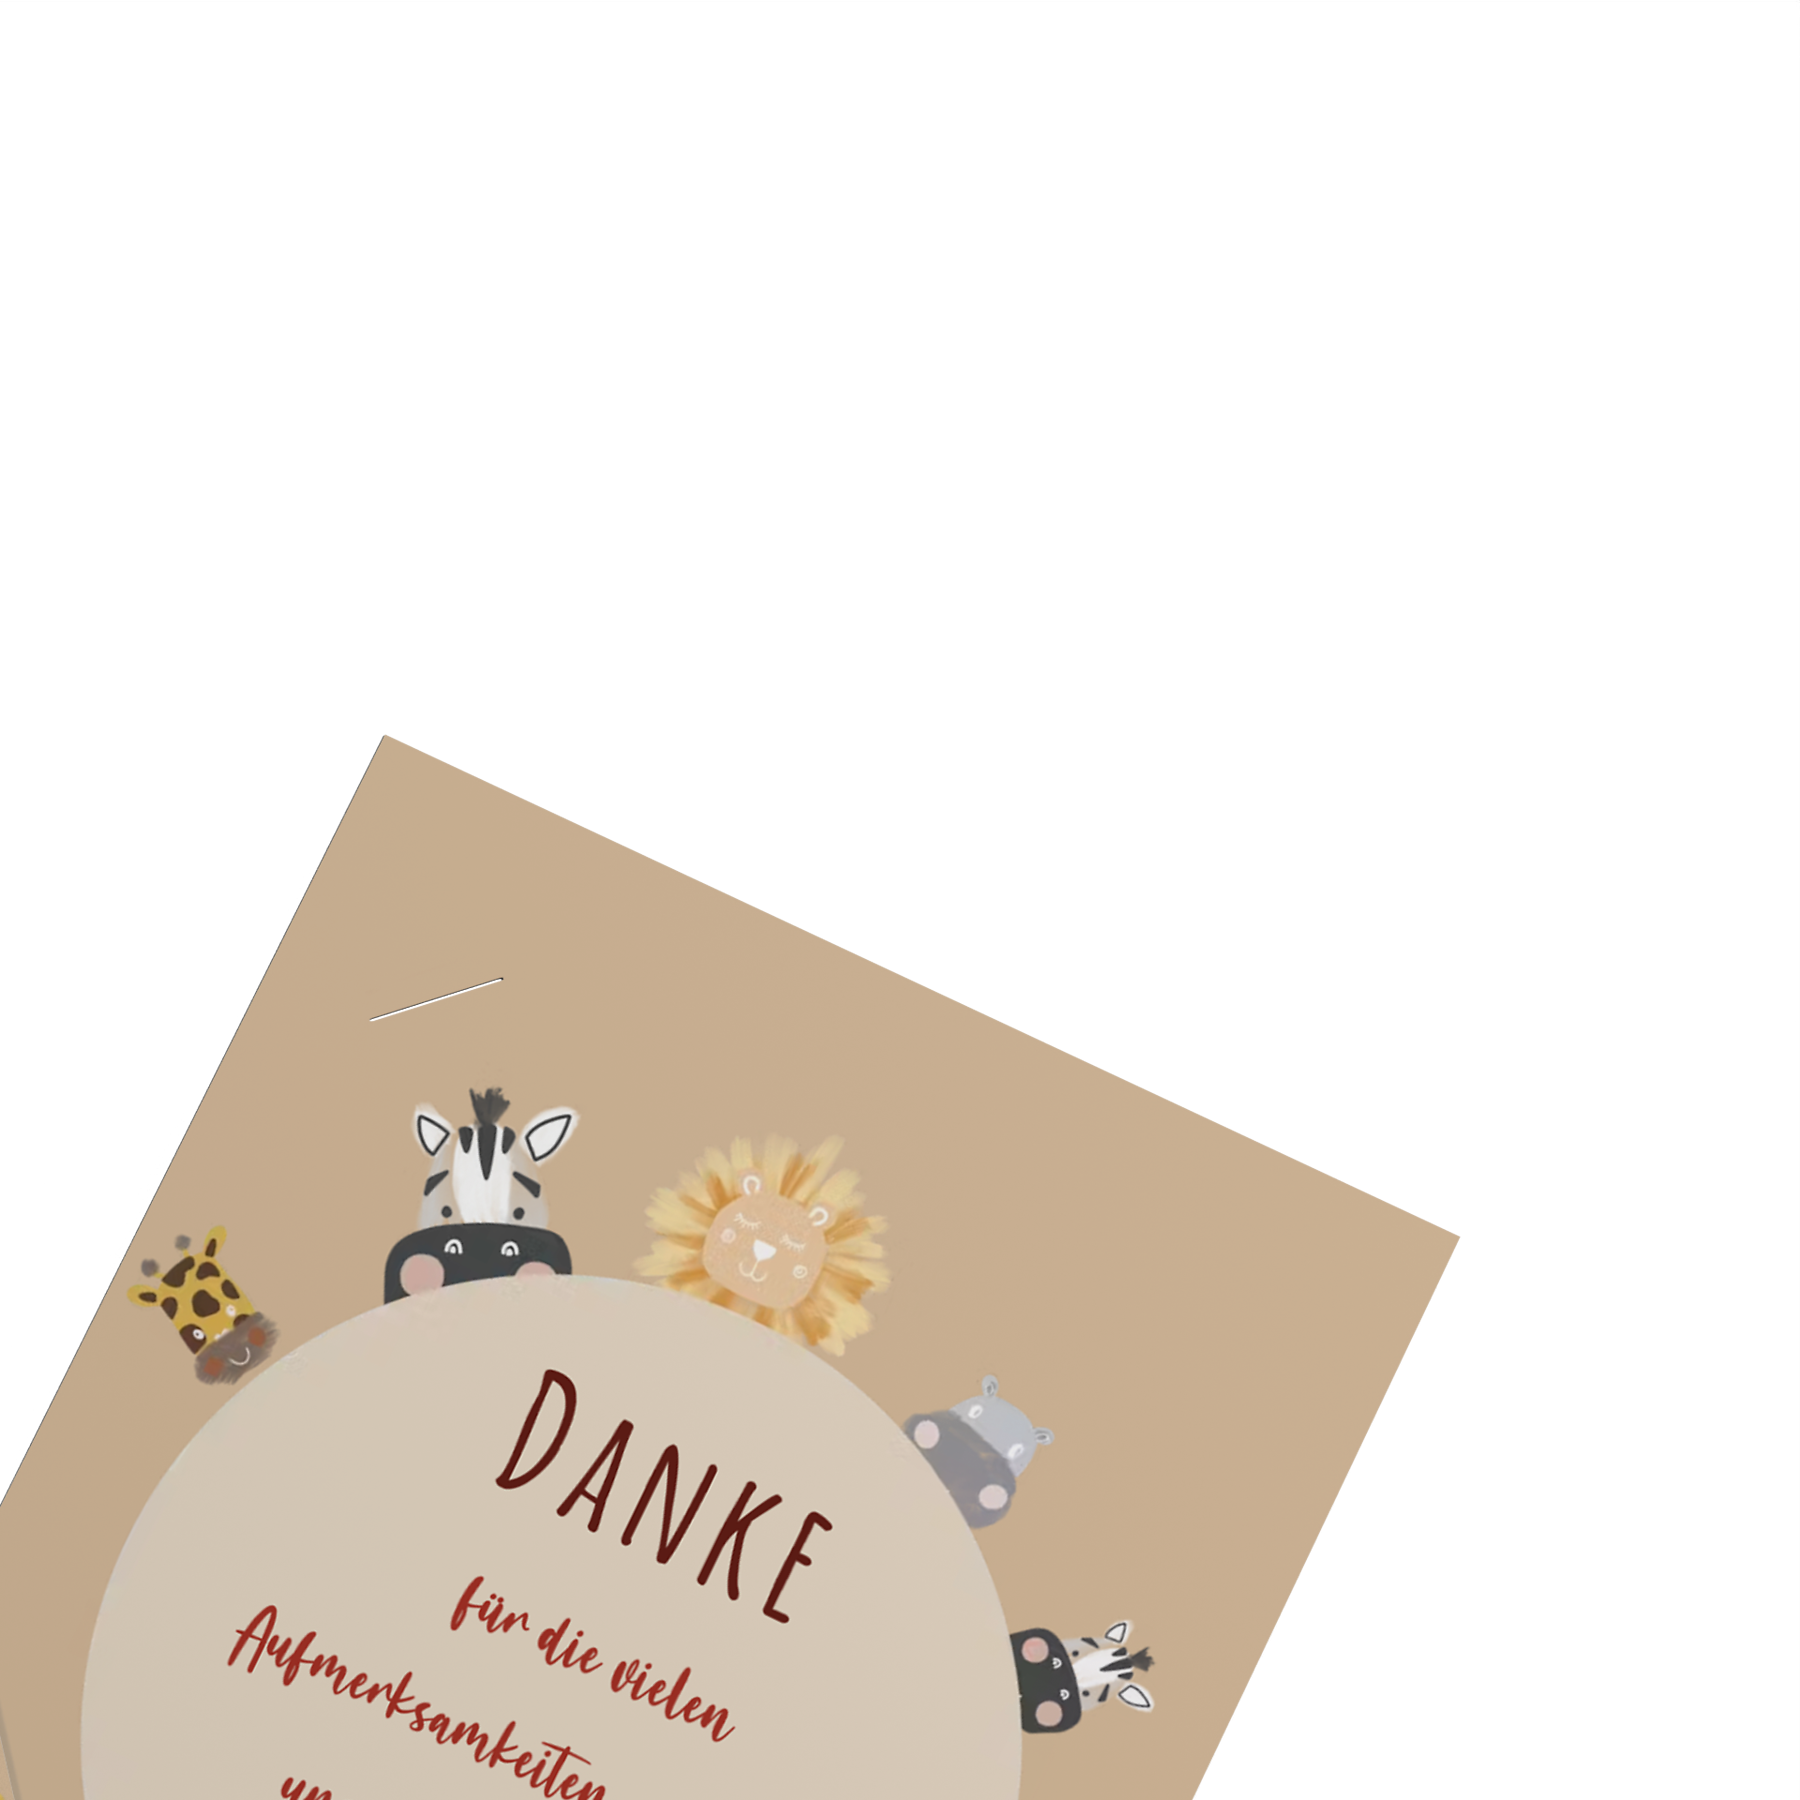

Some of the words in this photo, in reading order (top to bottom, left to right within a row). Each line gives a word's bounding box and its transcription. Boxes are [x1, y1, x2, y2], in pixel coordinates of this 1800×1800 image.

[496, 1370, 832, 1623] DANKE
[451, 1576, 529, 1633] für
[538, 1618, 603, 1673] die
[611, 1660, 735, 1742] vielen
